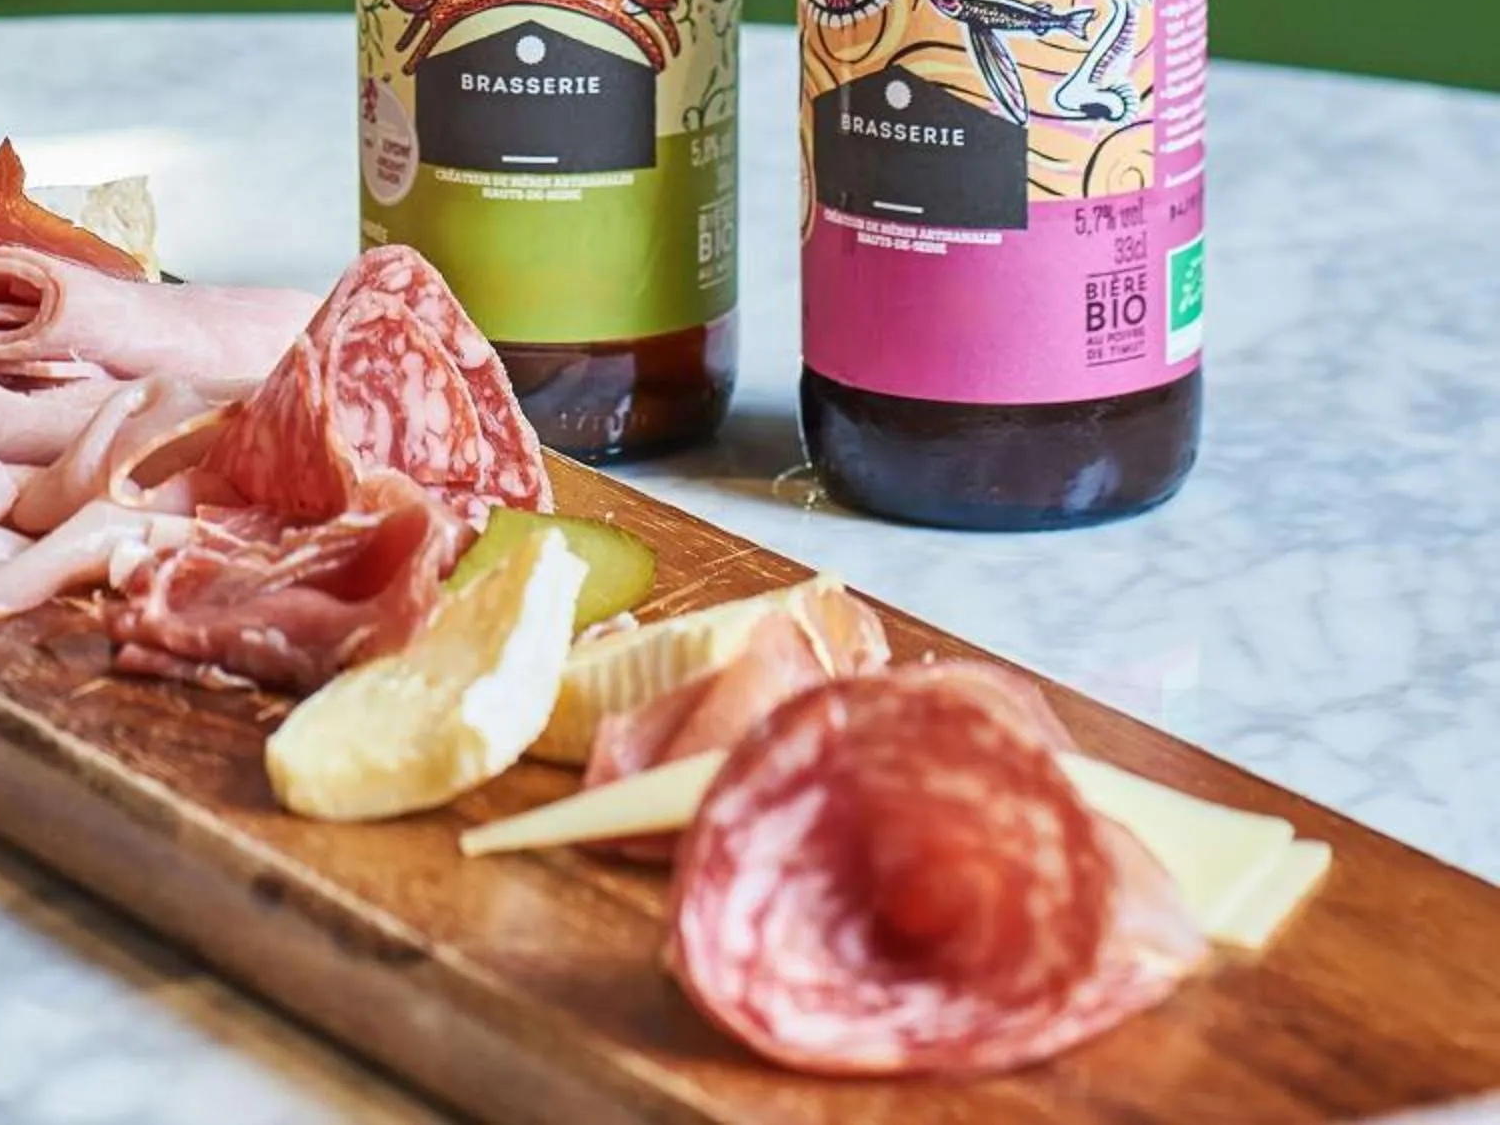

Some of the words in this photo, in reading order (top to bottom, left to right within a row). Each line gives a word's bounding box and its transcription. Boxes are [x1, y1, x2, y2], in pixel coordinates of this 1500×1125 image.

[460, 73, 601, 94] BRASSERIE
[840, 113, 965, 146] BRASSERIE
[1074, 203, 1117, 236] 5.7%
[1114, 231, 1148, 265] 33cl
[1085, 272, 1148, 300] BIÈRE
[1085, 293, 1147, 333] BIO
